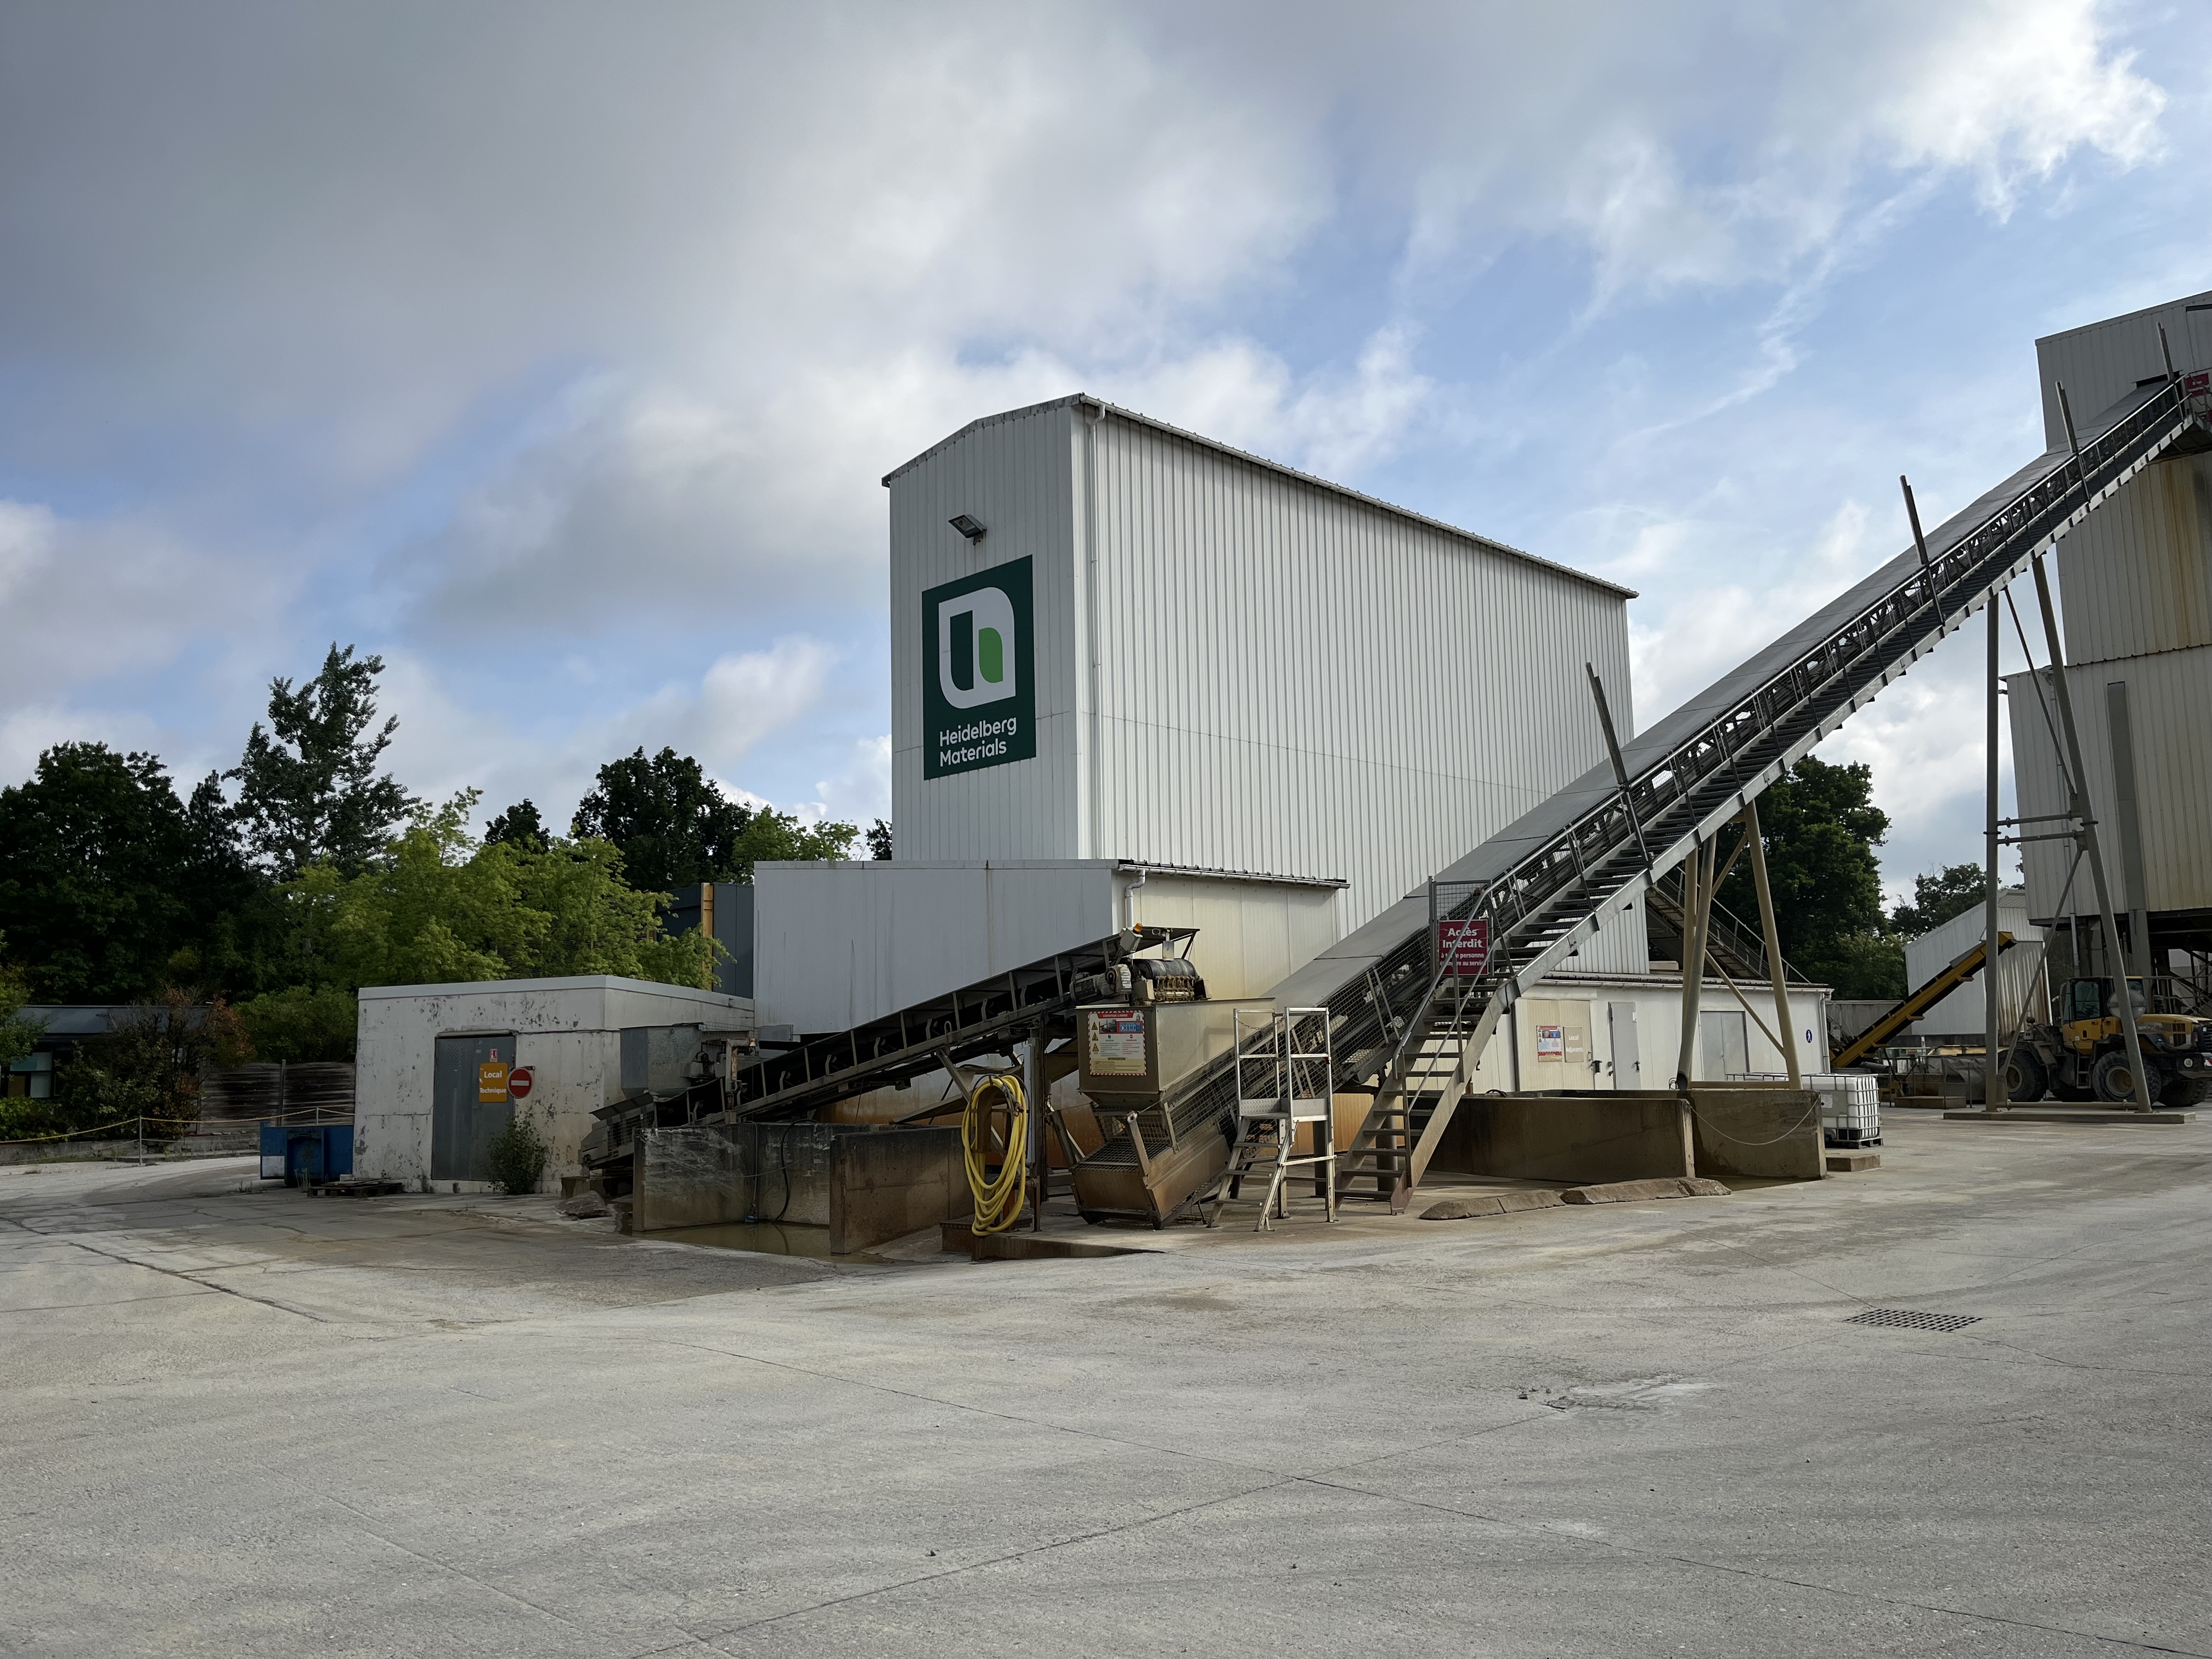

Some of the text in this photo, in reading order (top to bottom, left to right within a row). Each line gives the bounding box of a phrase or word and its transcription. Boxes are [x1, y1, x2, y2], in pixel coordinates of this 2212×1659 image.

[940, 717, 1017, 747] Heidelberg
[940, 738, 1007, 767] Materials
[1448, 927, 1477, 936] Acès
[484, 1070, 503, 1079] Local
